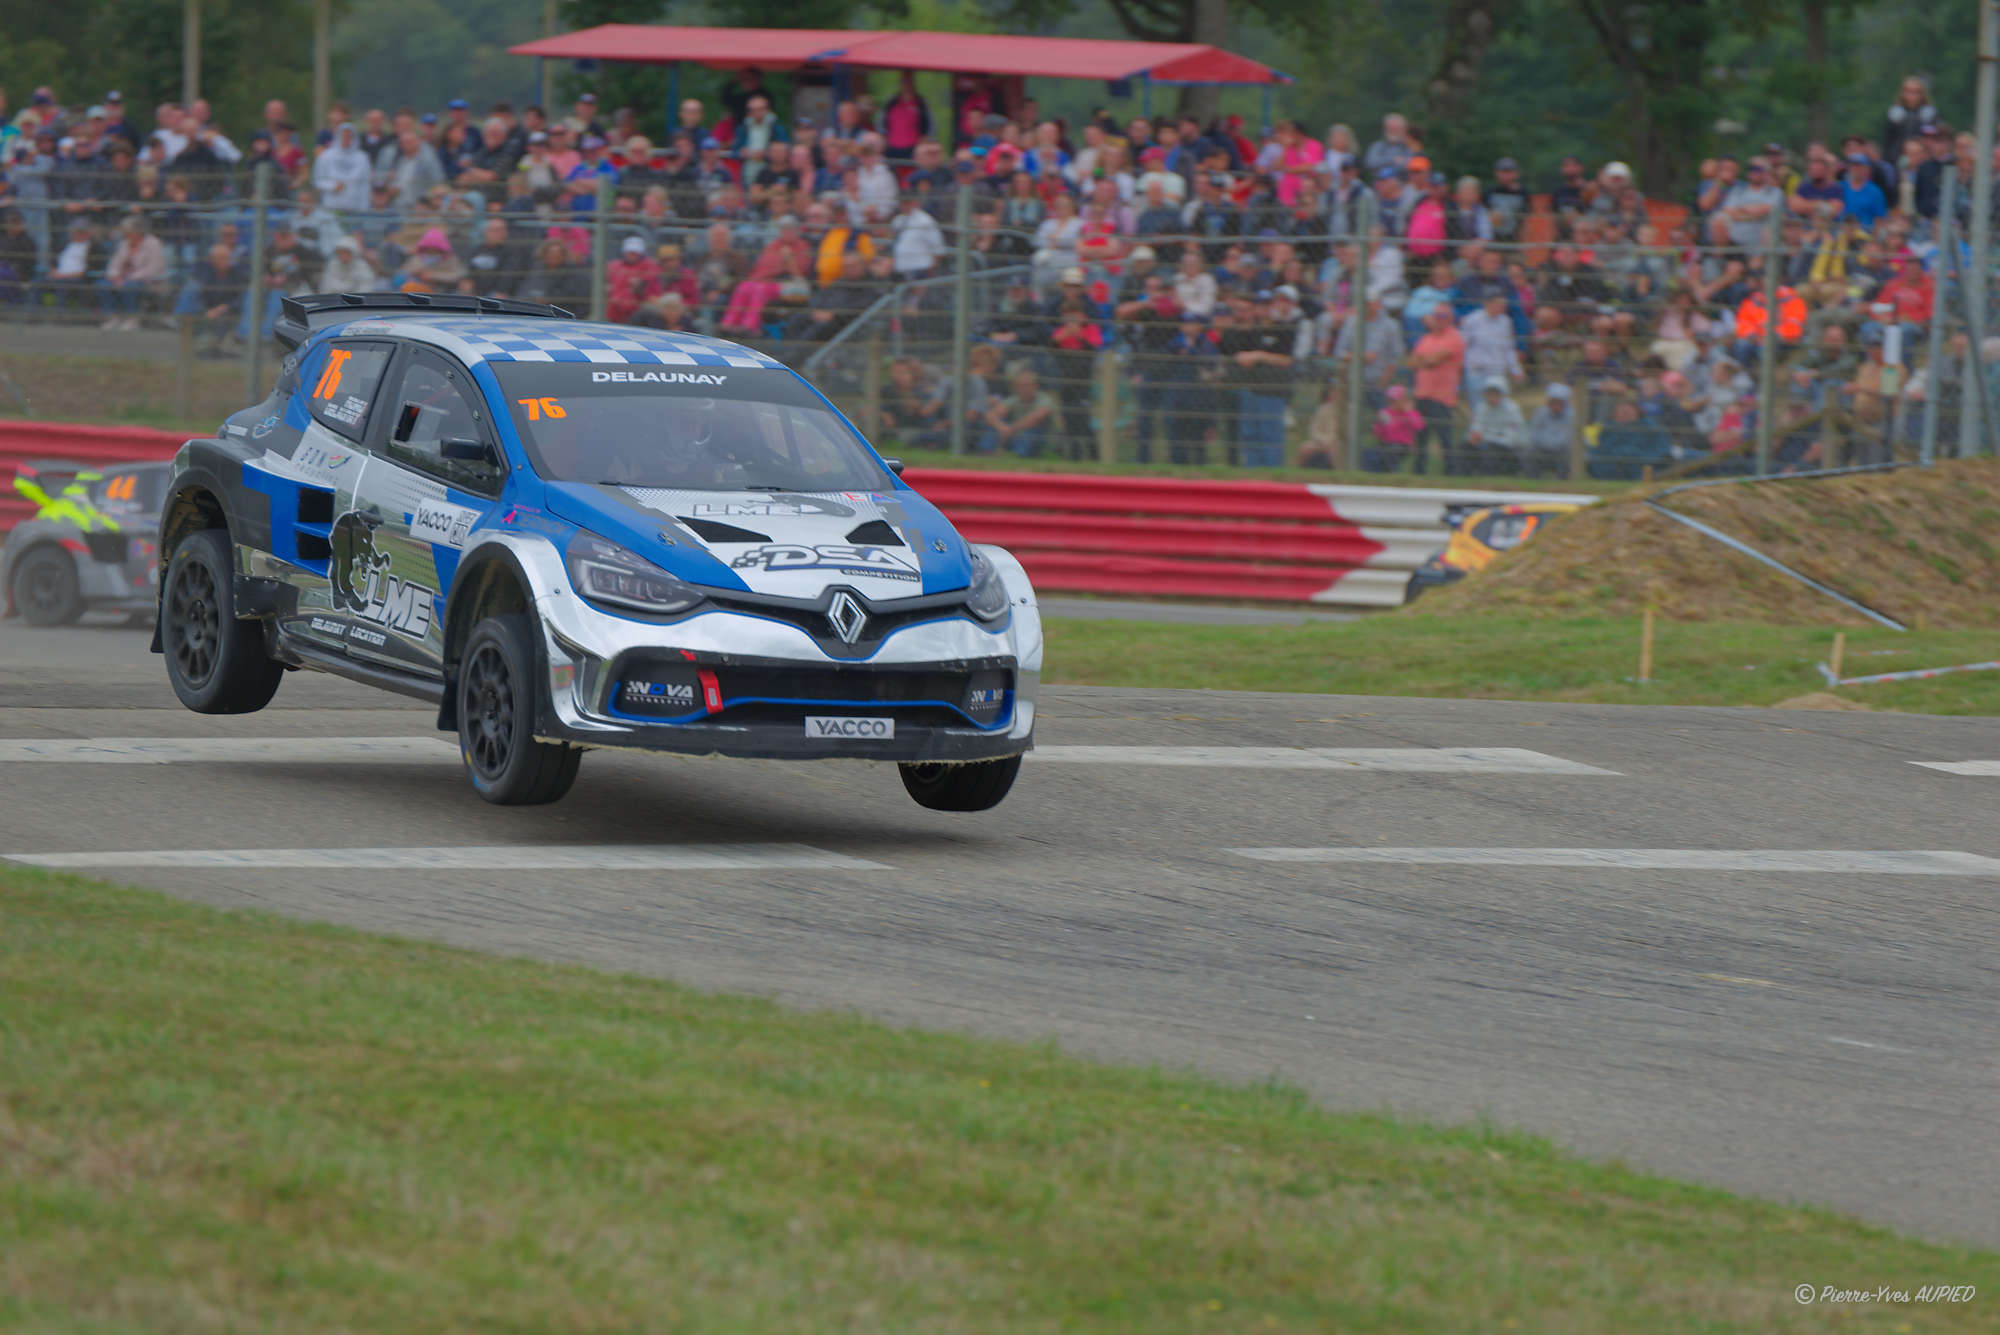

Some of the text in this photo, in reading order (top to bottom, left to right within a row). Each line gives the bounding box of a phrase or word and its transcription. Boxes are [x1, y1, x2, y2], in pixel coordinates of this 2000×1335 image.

[312, 348, 352, 400] 76
[592, 371, 727, 385] DELAUNAY
[517, 397, 567, 421] 76
[416, 507, 453, 532] YACCO
[764, 544, 914, 572] DSA
[843, 569, 918, 582] COMPETITION
[356, 569, 434, 642] LME
[815, 719, 887, 736] YACCO
